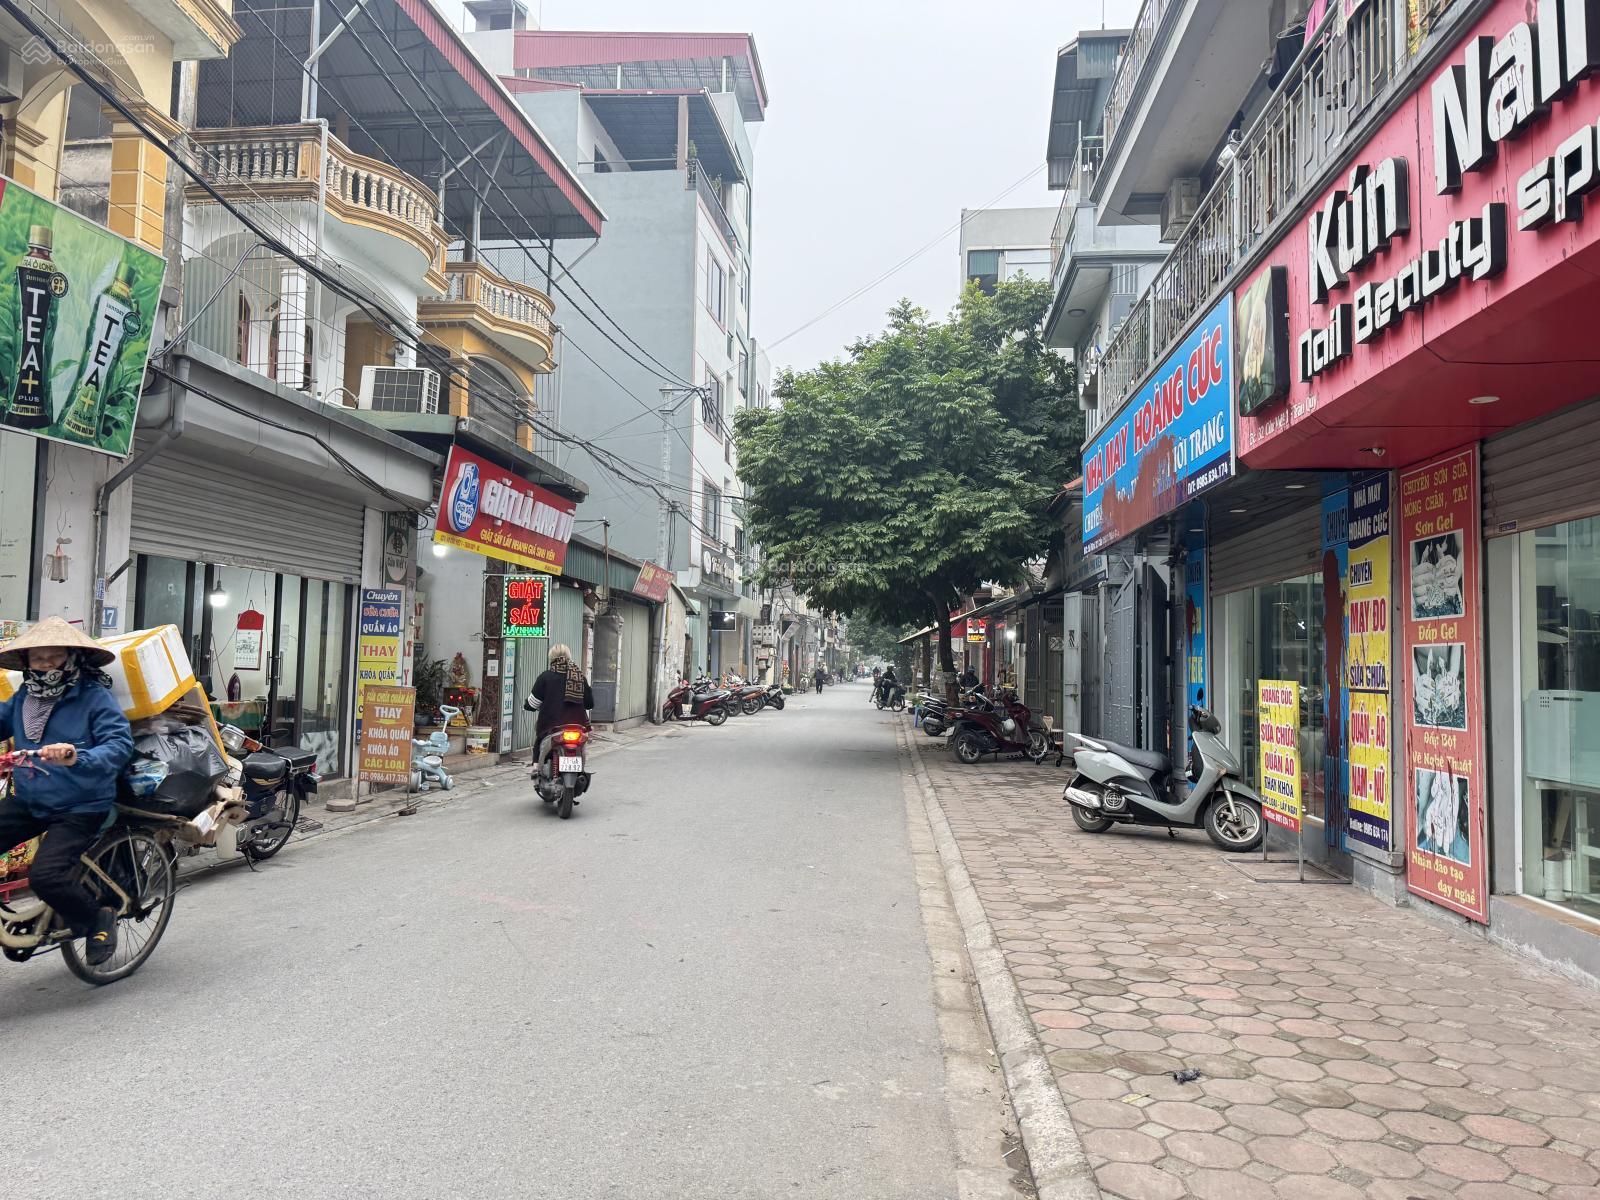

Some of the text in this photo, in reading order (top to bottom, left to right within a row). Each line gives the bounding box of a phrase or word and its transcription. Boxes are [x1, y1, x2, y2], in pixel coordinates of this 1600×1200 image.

[1310, 155, 1409, 304] Kún
[1355, 203, 1507, 344] Beauty
[18, 395, 40, 403] PLUS
[1086, 447, 1105, 498] NHÀ
[1105, 421, 1129, 481] MAY
[1134, 365, 1183, 456] HOÀNG
[1187, 324, 1222, 405] CÚC
[1190, 411, 1224, 463] TRANG
[1403, 472, 1429, 496] CHUYÊN
[1433, 468, 1448, 486] SƠN
[1353, 482, 1381, 509] NHÀ MAY
[1452, 485, 1468, 504] TAY
[1349, 509, 1388, 541] HOÀNG CÚC
[1415, 512, 1454, 537] Sơn Gel
[1350, 558, 1372, 585] CHUYÊN
[367, 590, 398, 602] Chuyên
[509, 578, 544, 602] GIẶT
[510, 602, 540, 625] SẤY
[1350, 598, 1386, 634] MAY ĐO
[387, 622, 398, 633] ÁO
[519, 626, 543, 634] NHANH
[1419, 622, 1458, 643] Đắp Gel
[362, 645, 396, 657] THAY
[360, 668, 376, 679] KHÓA
[1350, 657, 1386, 688] SỬA CHỮA
[1262, 685, 1293, 705] HOÀNG CÚC
[374, 706, 402, 719] THAY
[1352, 701, 1369, 746] QUẦN
[1376, 707, 1386, 748] ÁO
[368, 727, 388, 739] KHÓA
[1261, 718, 1296, 748] SỬA CHỮA
[367, 743, 388, 755] KHÓA
[389, 743, 399, 756] ÁO
[365, 758, 405, 771] CÁC LOẠI
[1265, 748, 1294, 777] QUẦN ÁO
[1264, 776, 1294, 798] THAY KHÓA
[1352, 765, 1368, 799] NAM
[1374, 765, 1385, 804] NỮ
[1411, 850, 1464, 882] Nhận đào tạo
[1437, 880, 1453, 897] dạy
